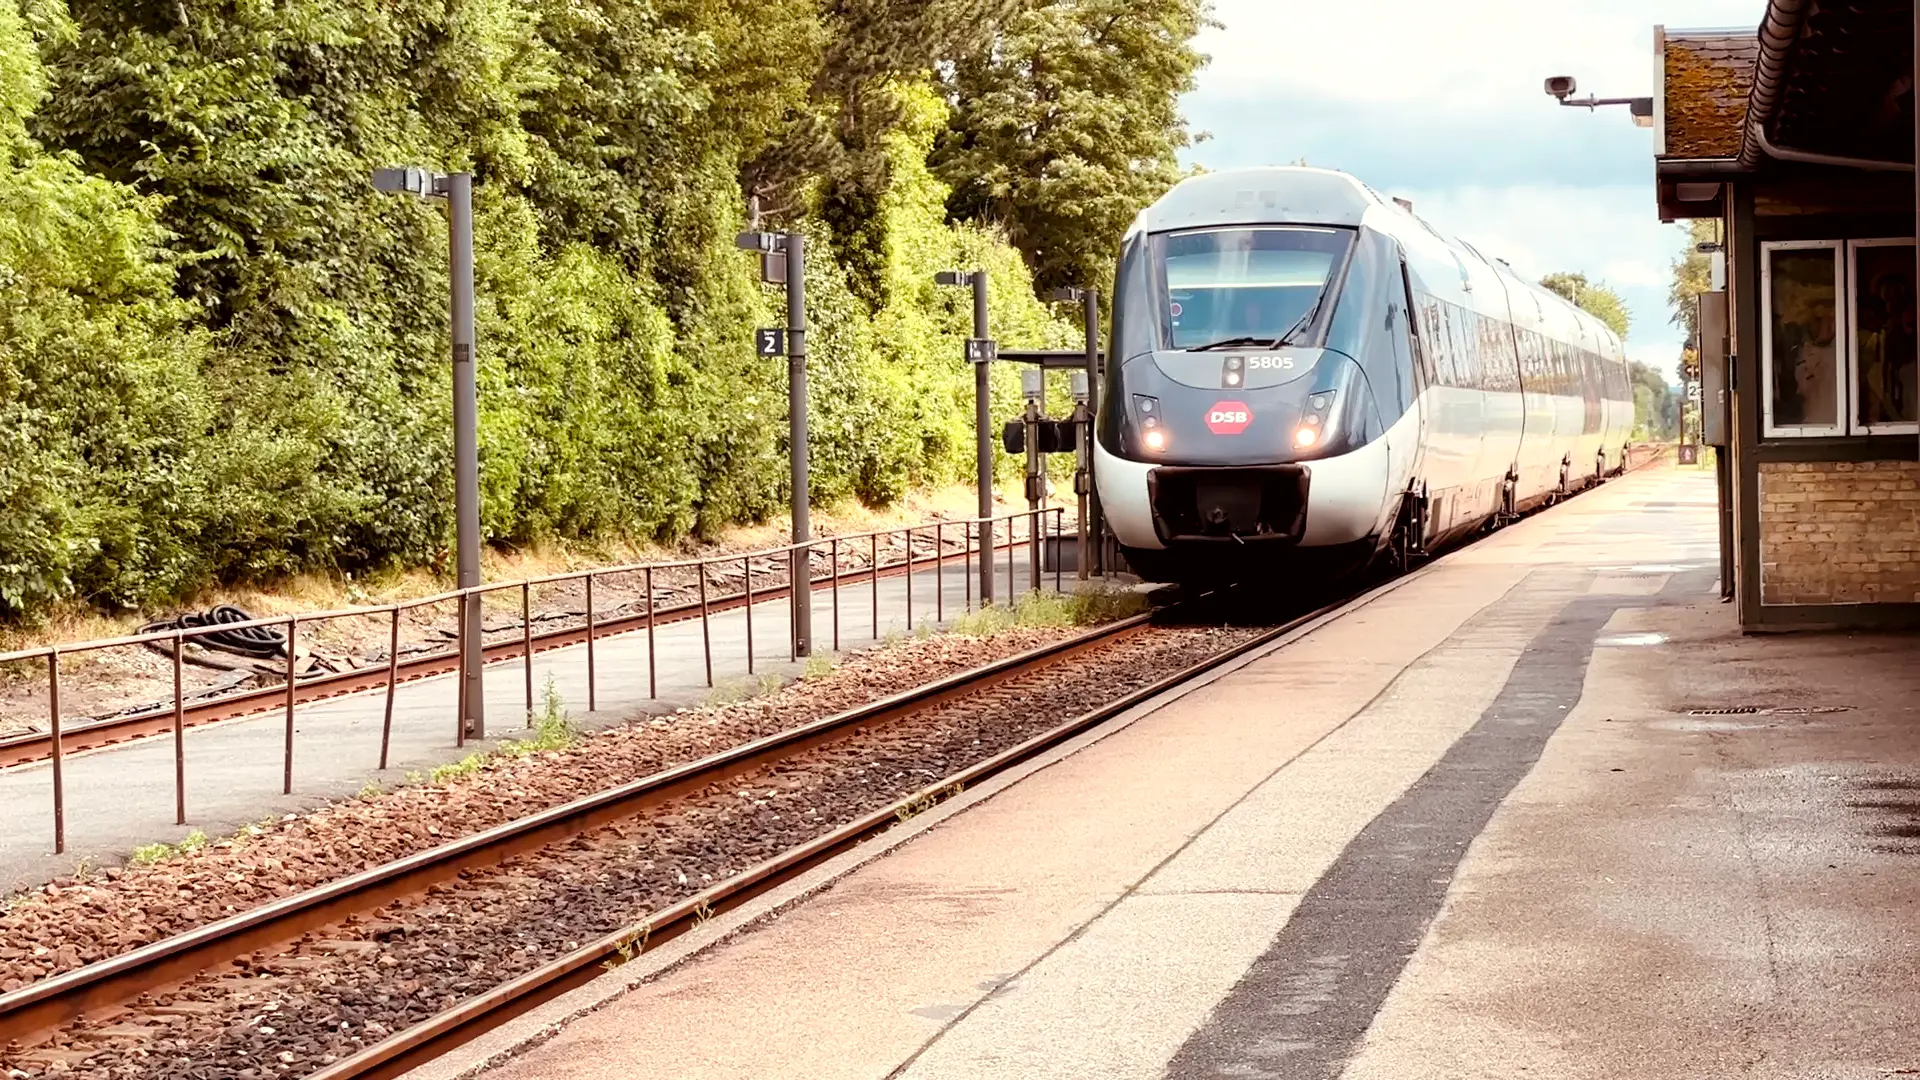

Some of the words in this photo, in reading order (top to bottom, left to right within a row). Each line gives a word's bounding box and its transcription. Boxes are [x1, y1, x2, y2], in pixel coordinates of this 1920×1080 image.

[764, 336, 776, 353] 2
[1249, 356, 1294, 369] 5805
[1210, 411, 1248, 424] DSB
